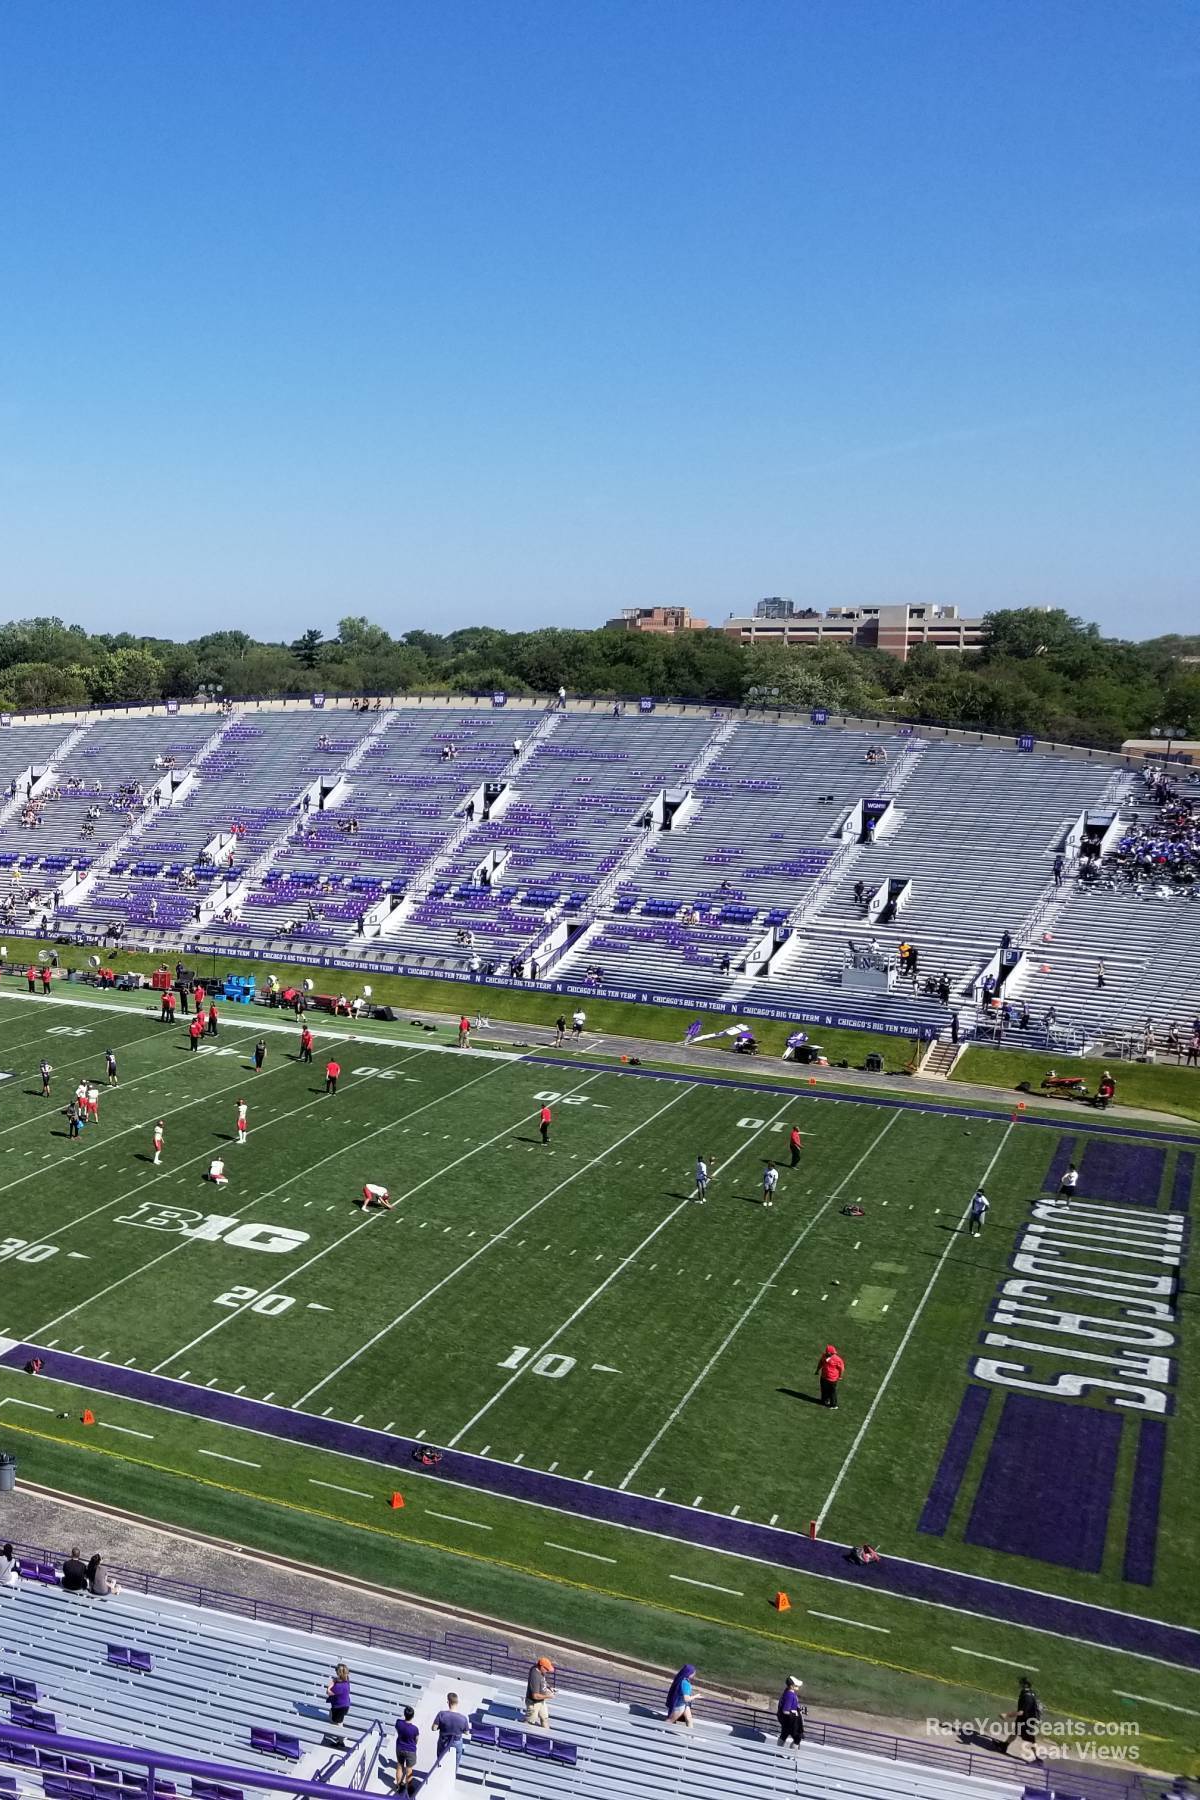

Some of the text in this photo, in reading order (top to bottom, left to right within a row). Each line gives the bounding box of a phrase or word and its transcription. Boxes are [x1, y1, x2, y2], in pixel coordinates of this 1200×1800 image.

[567, 985, 596, 995] CHICAGO'S
[620, 991, 637, 1000] TEAM
[653, 995, 683, 1006] CHICAGO'S
[709, 1002, 726, 1011] TEAM
[743, 1006, 775, 1017] CHICAGO'S
[802, 1013, 819, 1022] TEAM
[837, 1018, 871, 1029] CHICAGO'S
[899, 1025, 918, 1035] TEAM
[352, 1066, 405, 1080] 30
[533, 1091, 590, 1105] 20
[736, 1117, 790, 1133] 10
[213, 1285, 297, 1316] 20
[973, 1198, 1185, 1414] WILDCATS
[496, 1345, 578, 1378] 10
